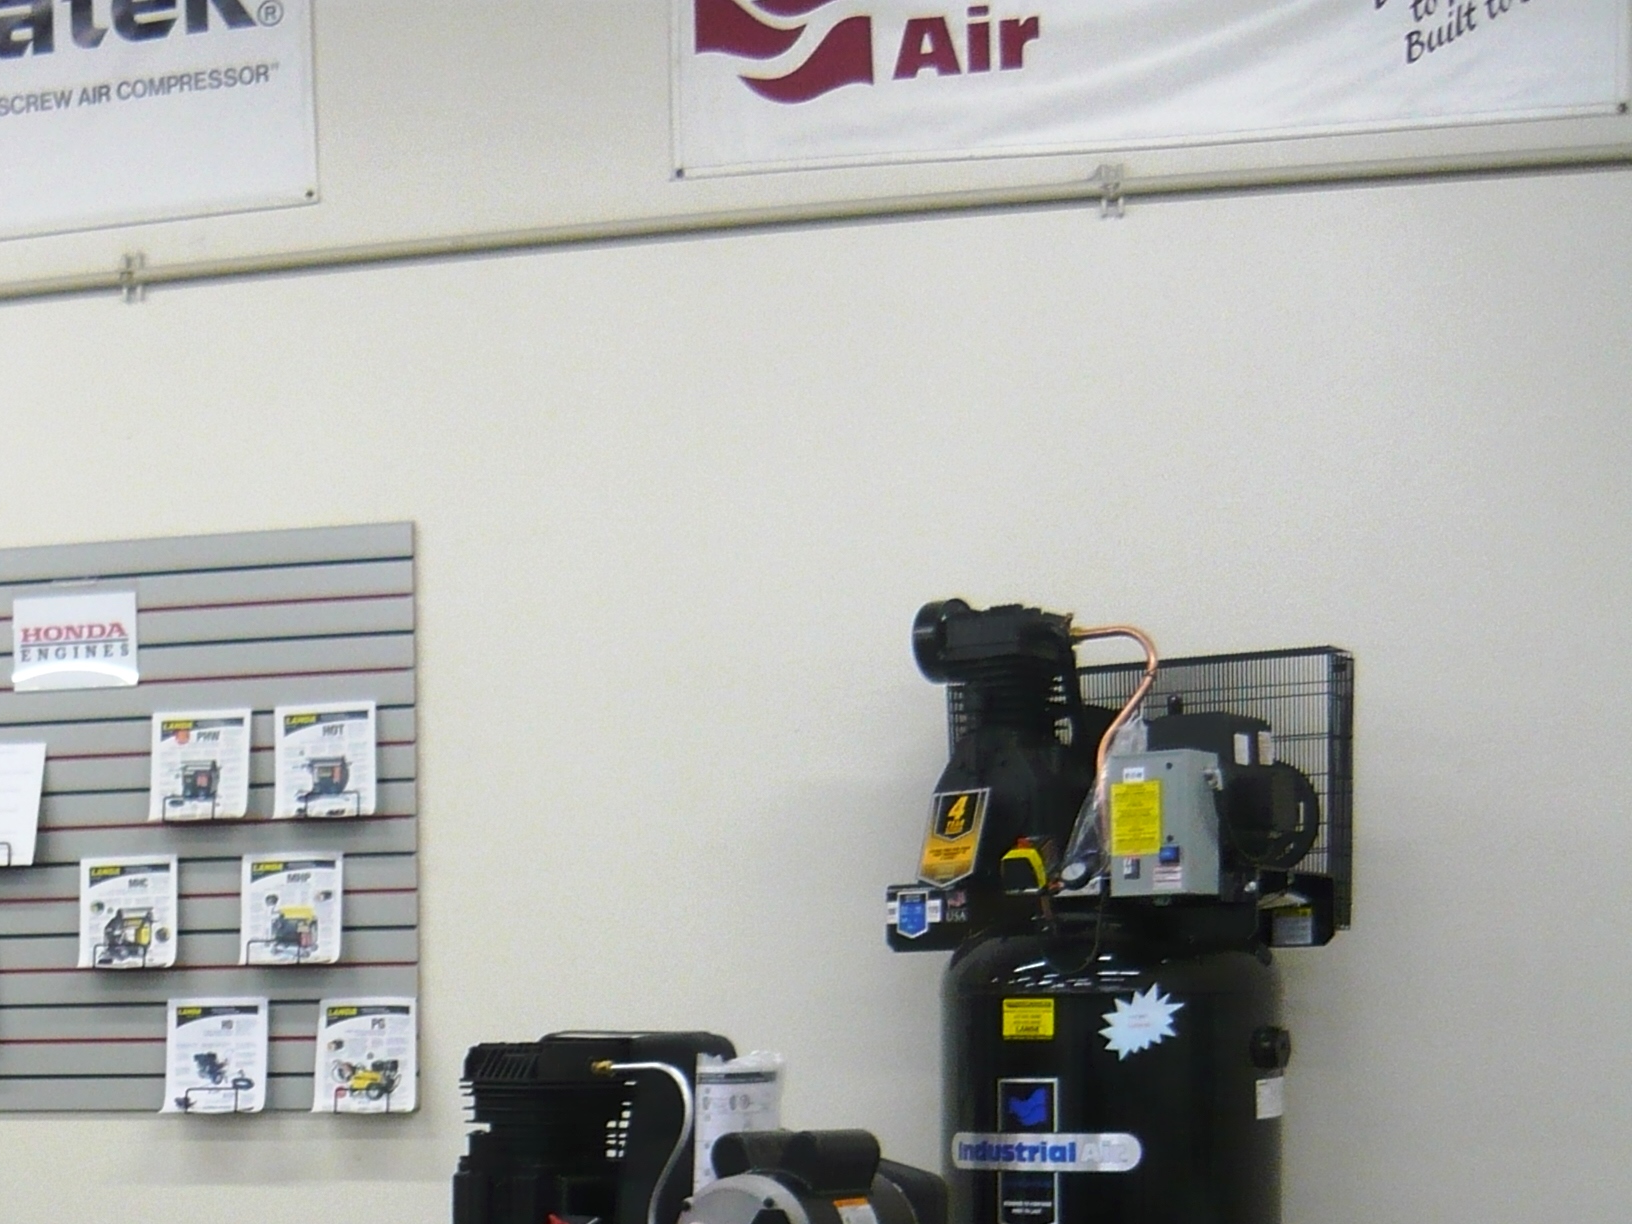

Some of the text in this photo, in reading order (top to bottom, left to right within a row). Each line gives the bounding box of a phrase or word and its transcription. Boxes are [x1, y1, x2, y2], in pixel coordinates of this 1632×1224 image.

[892, 5, 1040, 80] Air
[1405, 2, 1476, 64] Built
[78, 83, 111, 105] AIR
[21, 622, 128, 643] HONDA
[20, 644, 130, 663] ENGINES
[948, 795, 968, 819] 4
[958, 1141, 1076, 1163] Industrial
